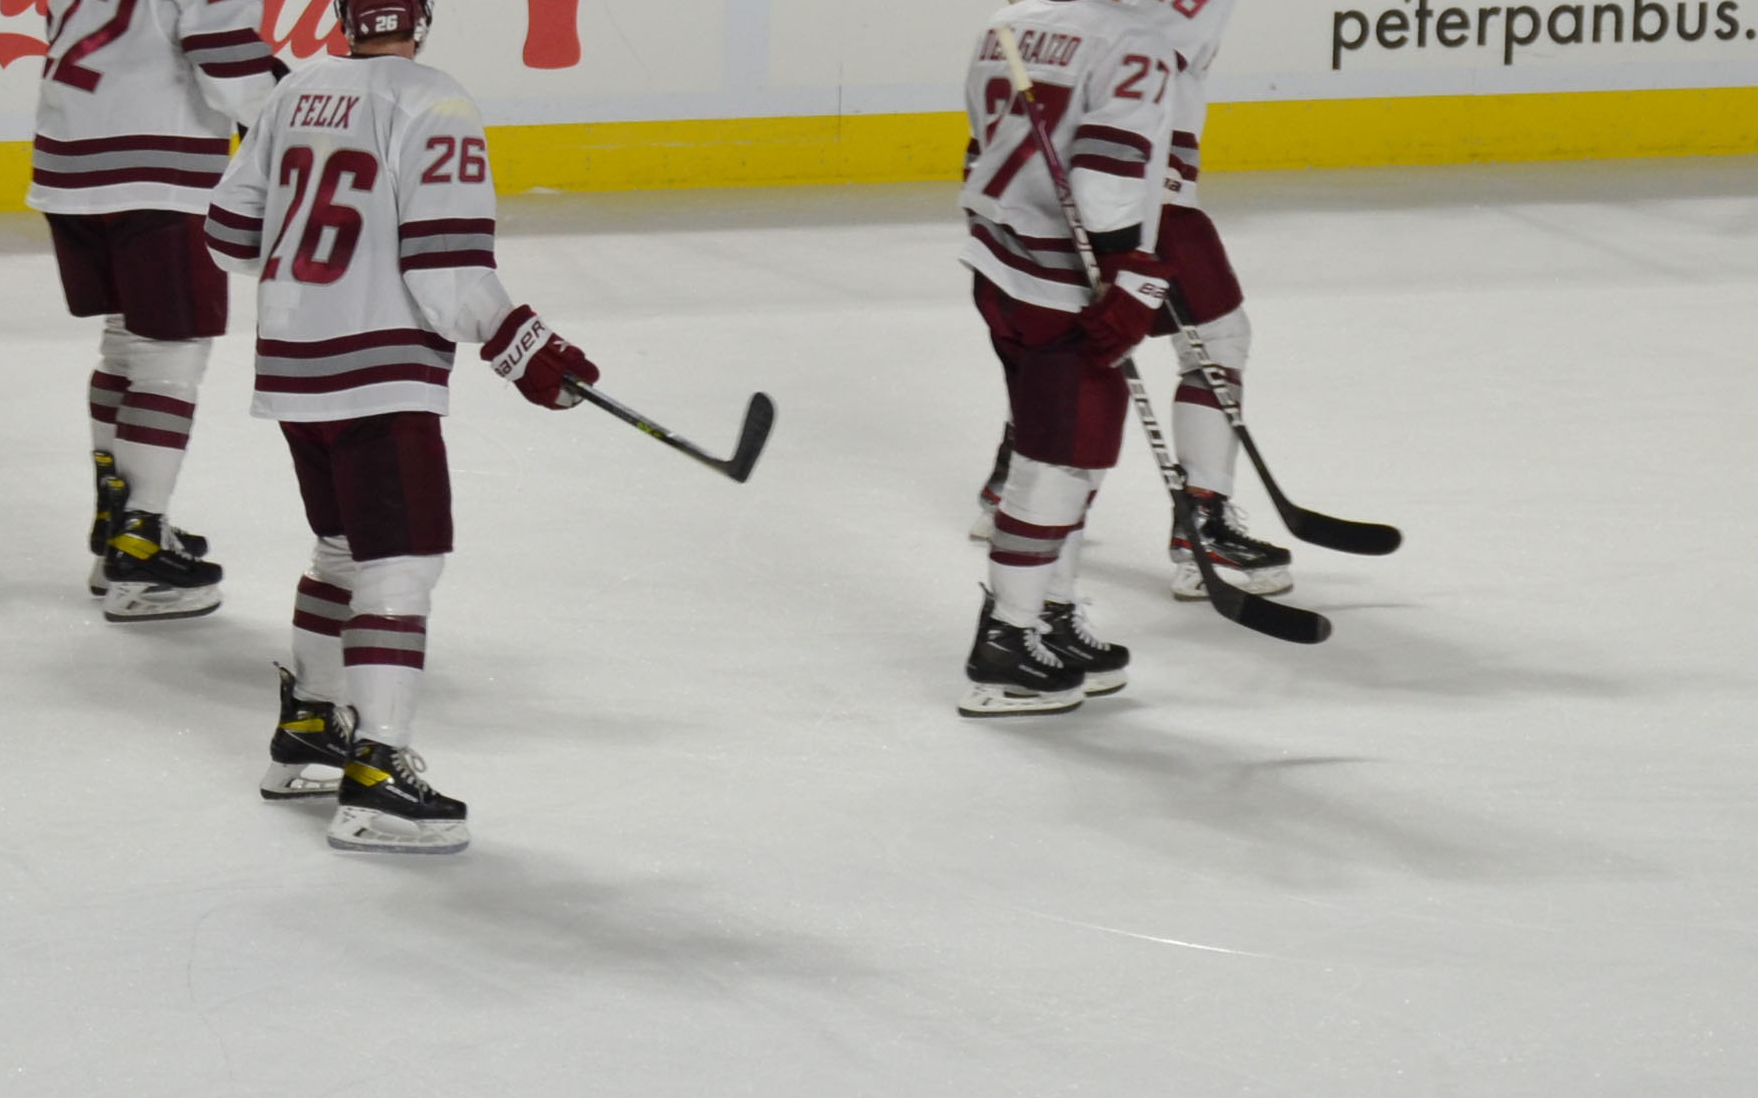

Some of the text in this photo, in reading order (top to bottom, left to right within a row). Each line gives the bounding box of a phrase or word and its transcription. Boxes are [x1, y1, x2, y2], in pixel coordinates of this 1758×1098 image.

[375, 14, 398, 33] 26
[1114, 54, 1170, 105] 27
[290, 94, 360, 129] FELIX
[421, 136, 486, 185] 26
[260, 146, 379, 285] 26
